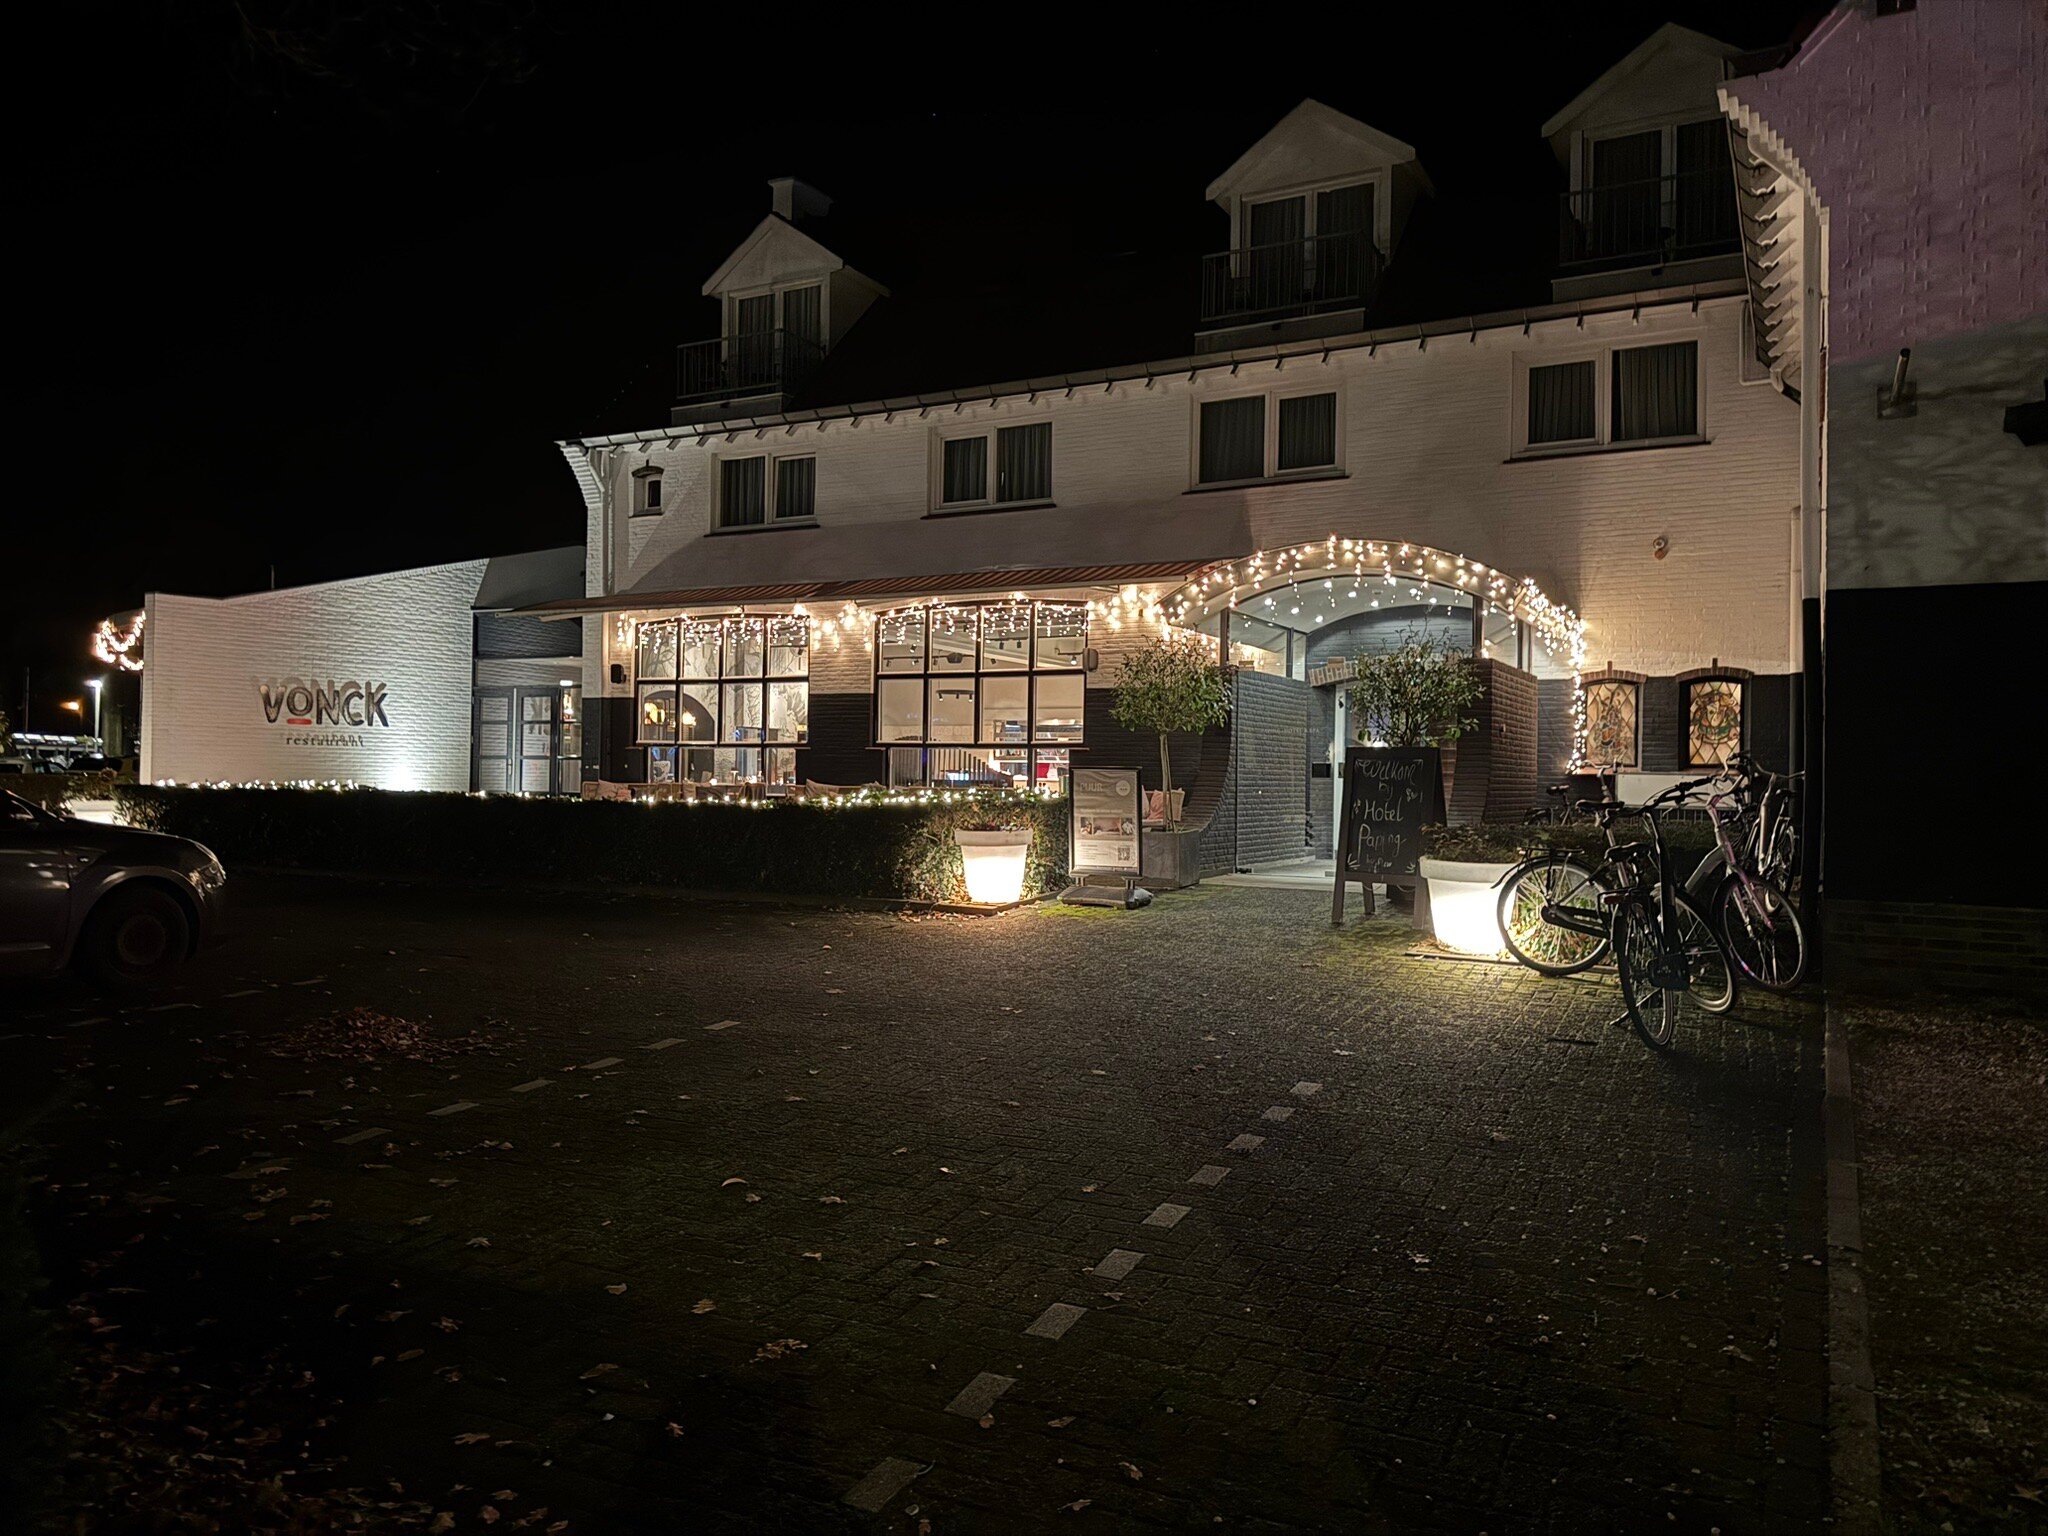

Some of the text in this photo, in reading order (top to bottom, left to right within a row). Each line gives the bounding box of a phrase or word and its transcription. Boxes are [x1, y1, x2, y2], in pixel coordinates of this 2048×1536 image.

[259, 684, 389, 728] VONCK
[286, 735, 365, 747] restaurant
[1364, 797, 1404, 822] Hotel
